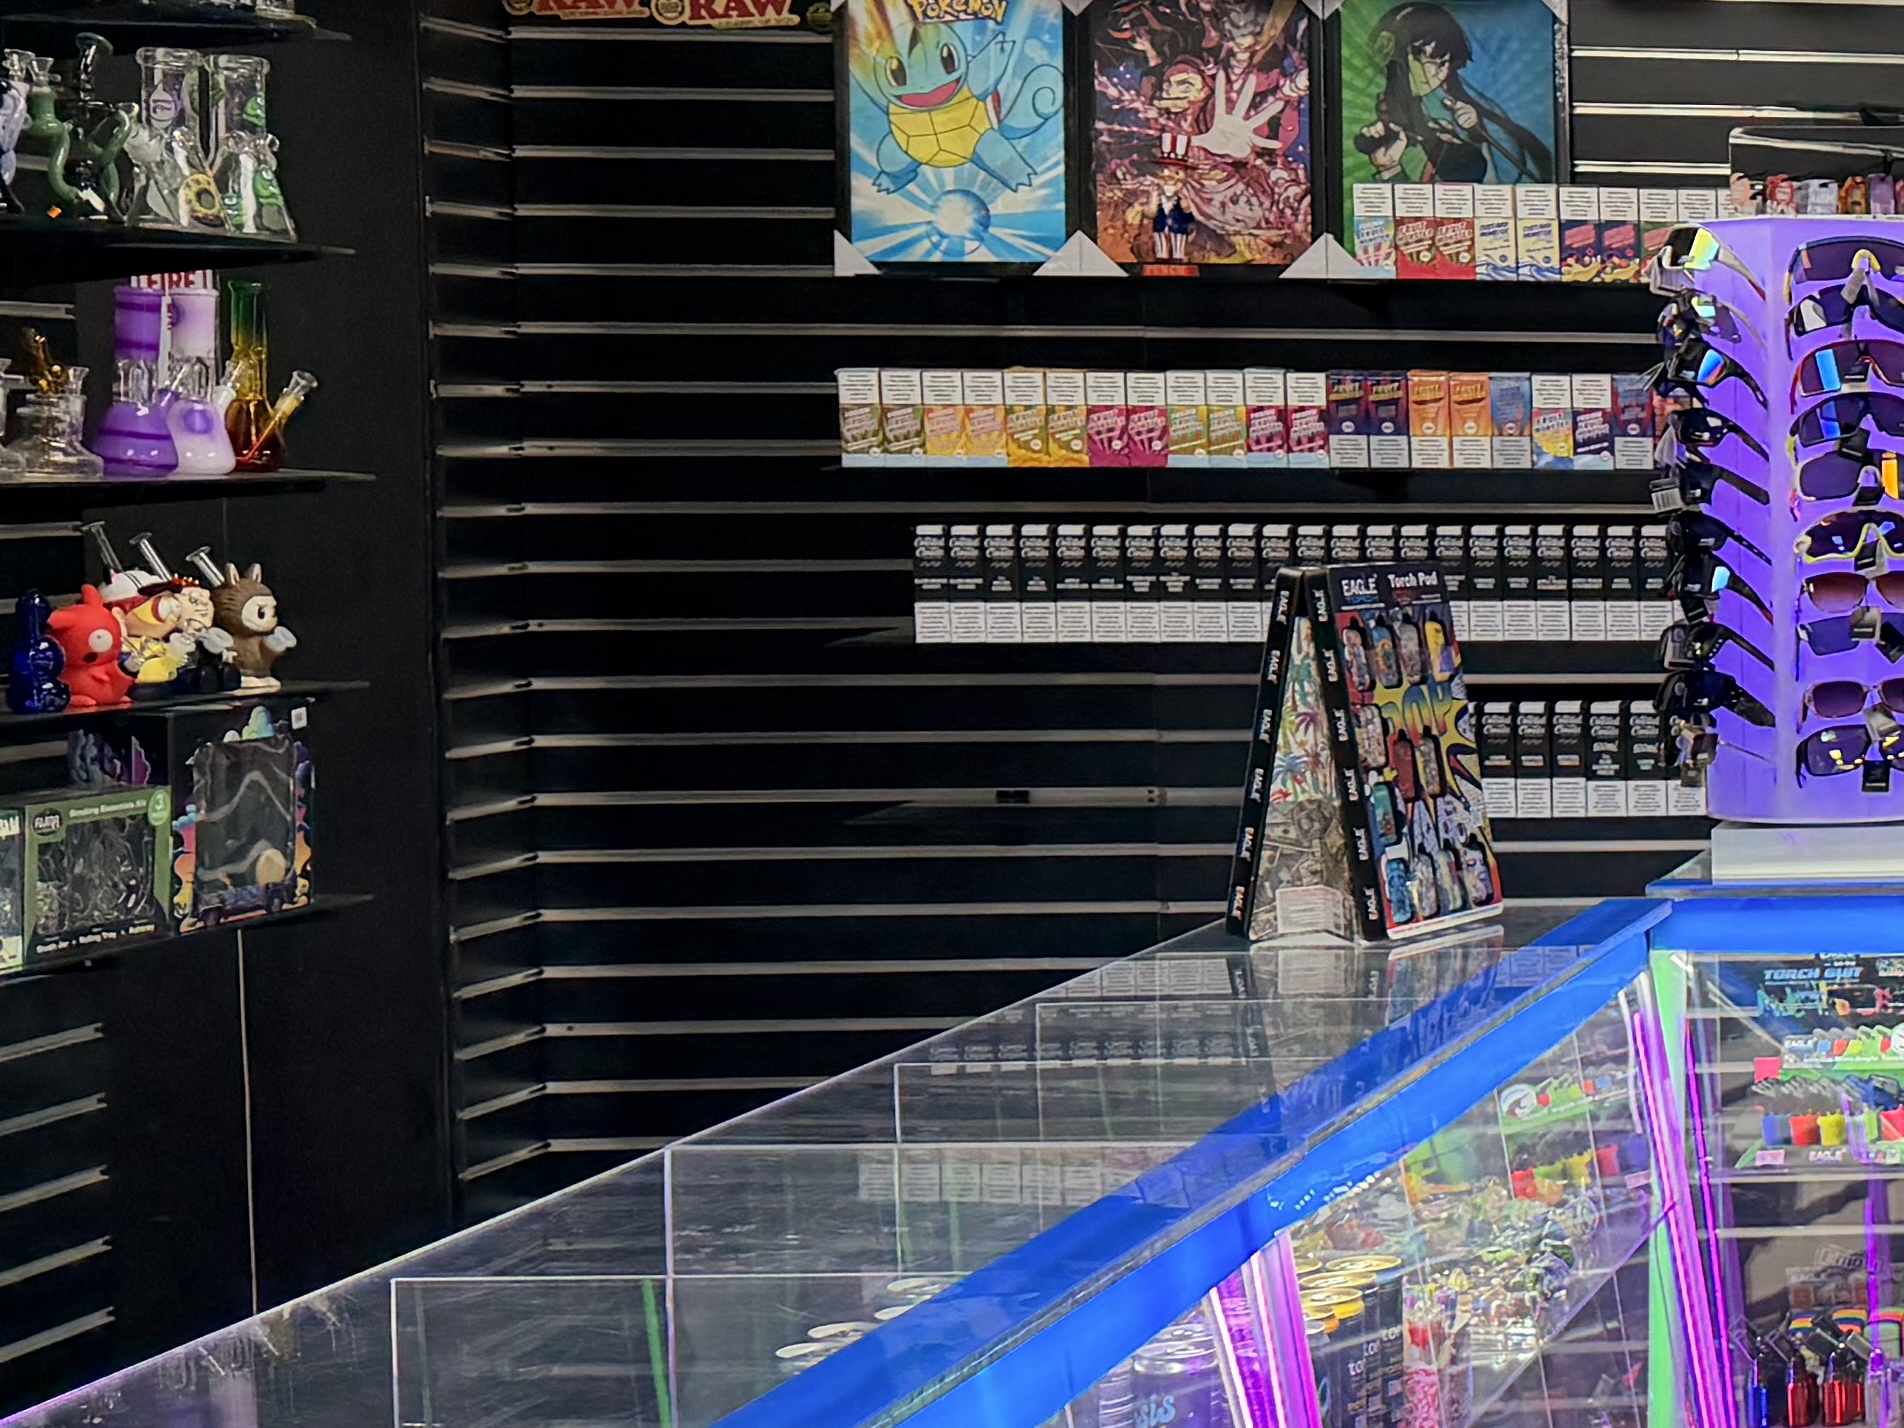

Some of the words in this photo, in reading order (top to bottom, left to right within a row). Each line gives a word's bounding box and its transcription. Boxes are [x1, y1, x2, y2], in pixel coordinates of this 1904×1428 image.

[1341, 577, 1377, 595] EAGLE
[1388, 574, 1417, 588] Torch
[1418, 571, 1437, 587] Pod
[1763, 967, 1819, 981] TORCH
